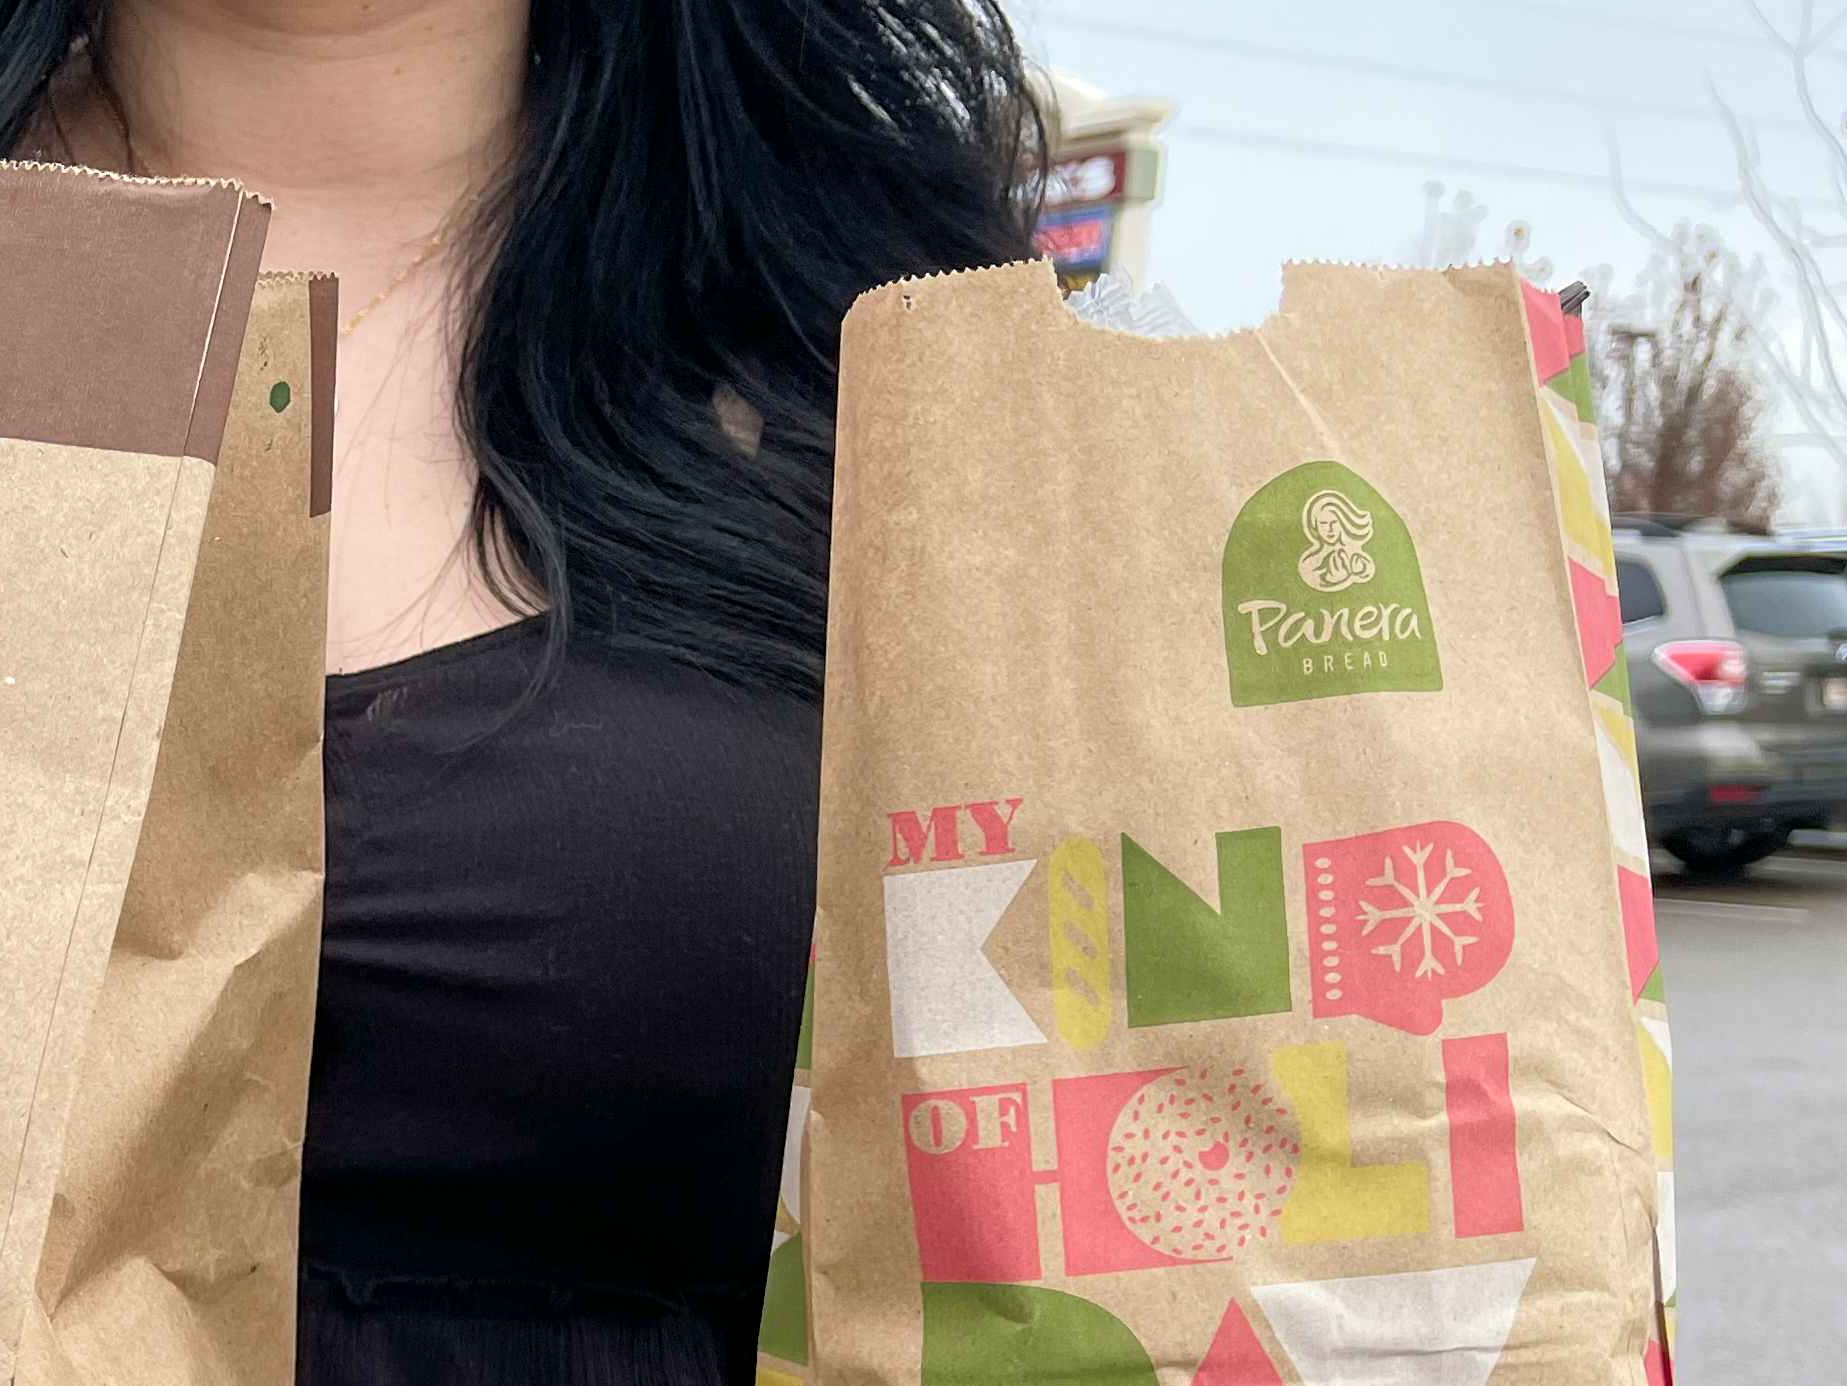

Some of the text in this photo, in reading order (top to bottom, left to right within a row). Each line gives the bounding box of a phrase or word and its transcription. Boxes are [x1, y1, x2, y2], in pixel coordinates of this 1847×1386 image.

[1237, 599, 1422, 656] Panera
[1302, 650, 1389, 676] BREAD
[885, 797, 1023, 868] MY
[883, 819, 1516, 1058] KIND
[908, 1090, 1023, 1155] OF
